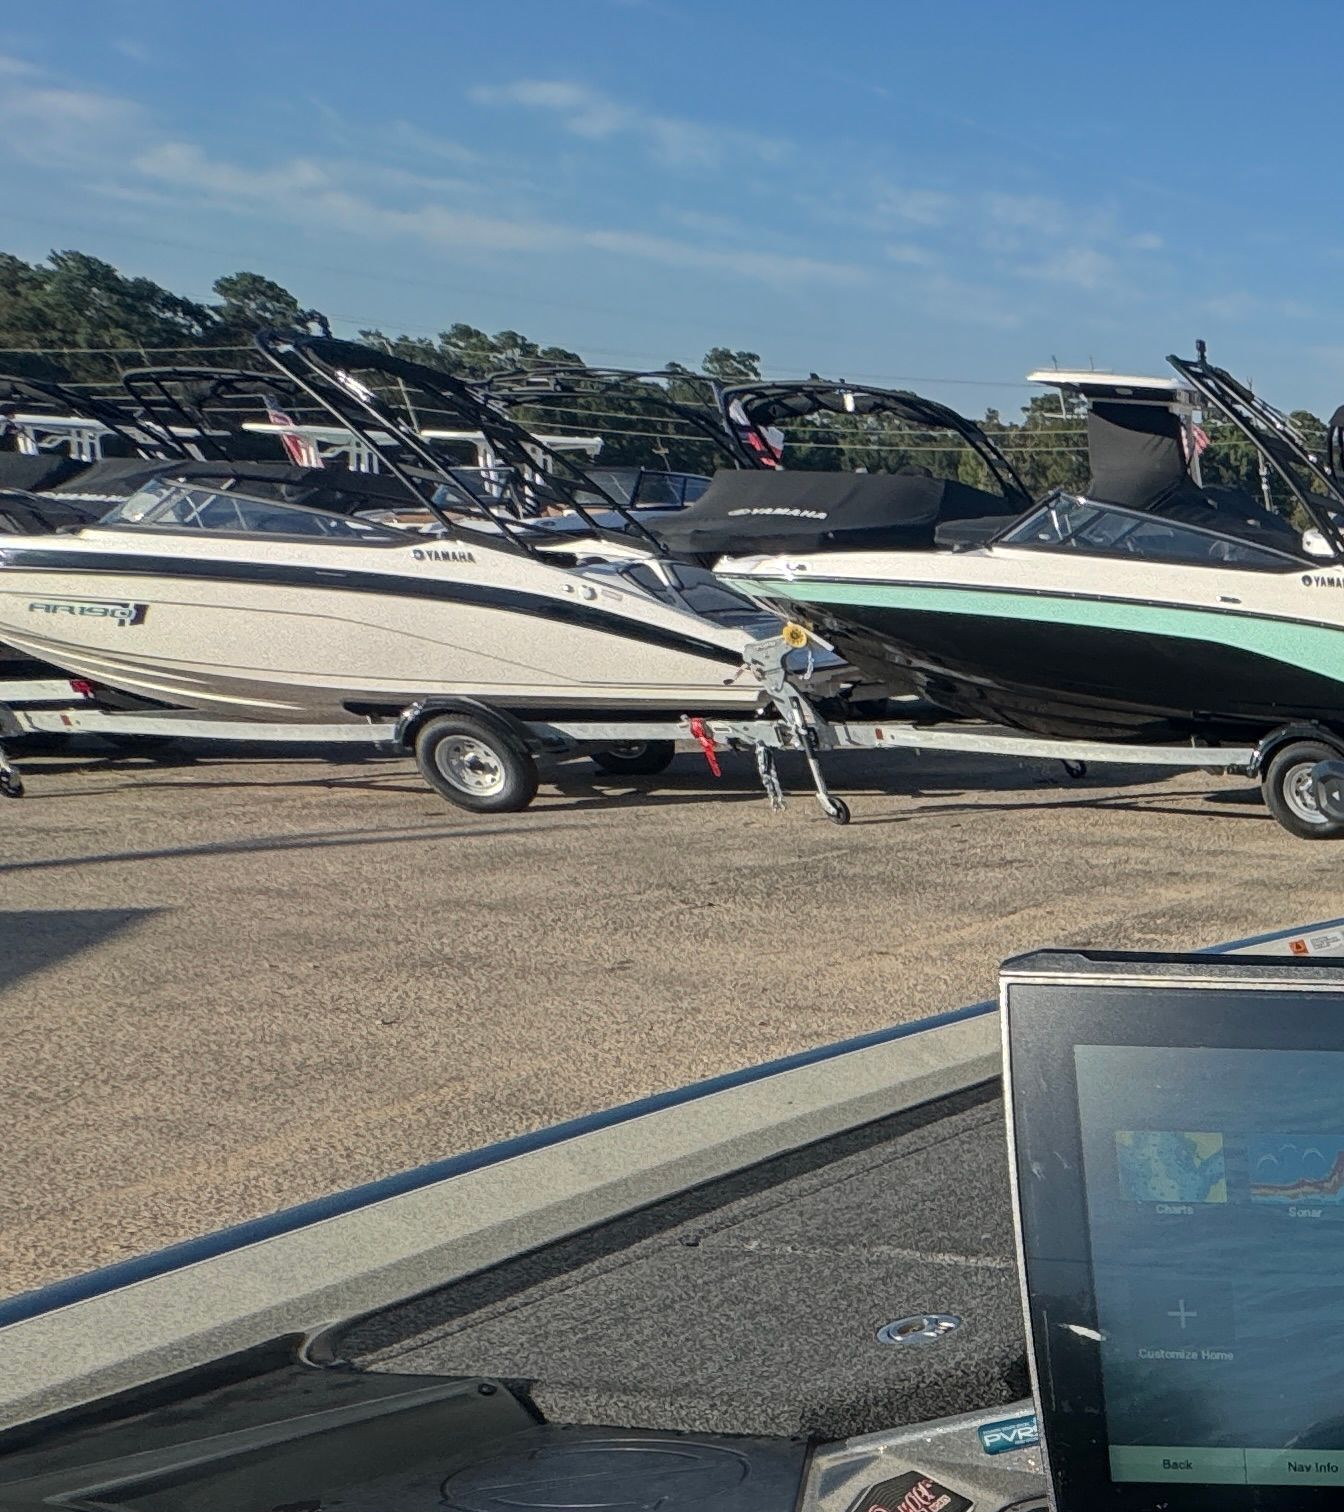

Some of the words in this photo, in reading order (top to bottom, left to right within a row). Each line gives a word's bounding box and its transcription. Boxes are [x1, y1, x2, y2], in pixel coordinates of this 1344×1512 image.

[425, 550, 476, 564] YAMAHA
[1155, 1203, 1195, 1216] Charts
[1288, 1206, 1323, 1218] Sonar
[1138, 1348, 1198, 1361] Customize
[1201, 1349, 1234, 1362] Home
[1162, 1459, 1193, 1471] Back
[1287, 1461, 1312, 1473] Nav
[1315, 1462, 1339, 1473] Info
